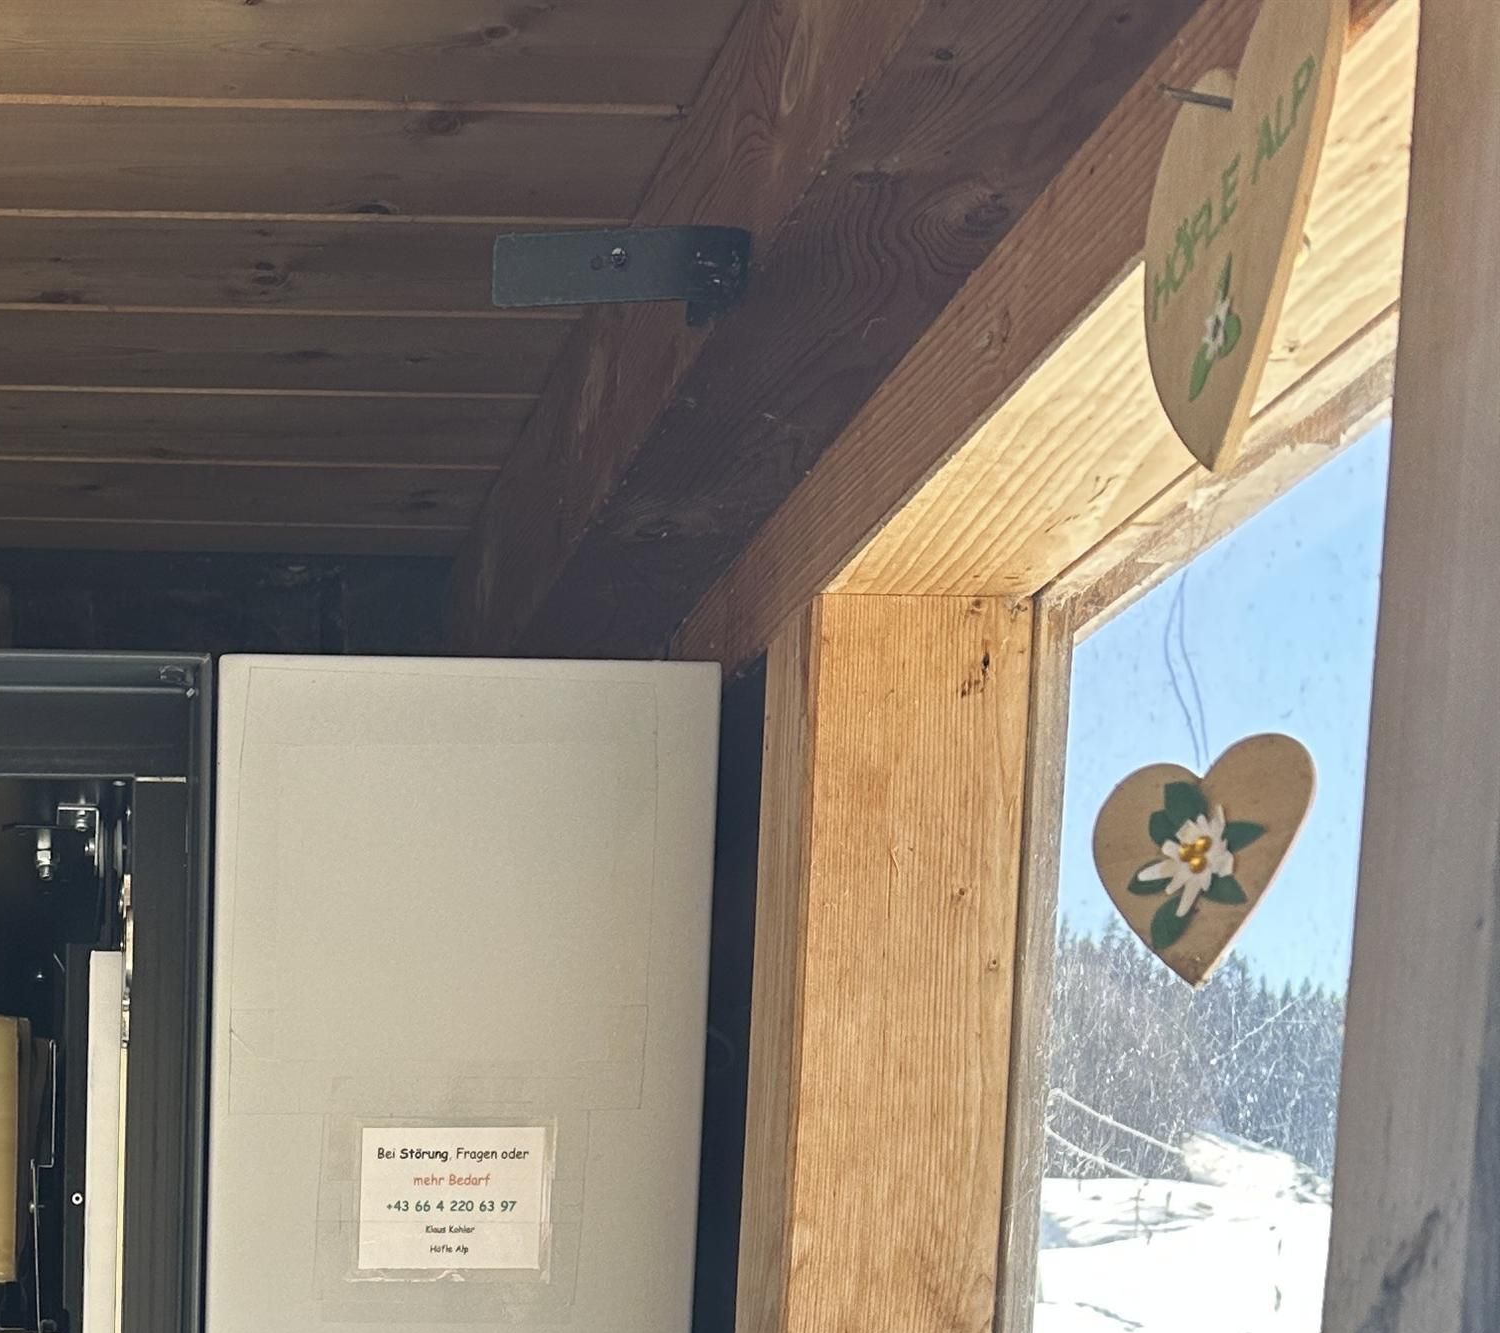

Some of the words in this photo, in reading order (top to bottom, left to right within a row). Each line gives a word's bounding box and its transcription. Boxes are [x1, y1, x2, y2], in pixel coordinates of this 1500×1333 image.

[1252, 56, 1315, 184] ALP
[377, 1147, 395, 1160] Bei
[399, 1148, 451, 1162] Störung,
[456, 1148, 497, 1162] Fragen
[501, 1148, 529, 1160] oder
[413, 1174, 445, 1186] mehr
[449, 1173, 491, 1186] Bedarf
[386, 1200, 409, 1212] +43
[415, 1200, 431, 1212] 66
[436, 1200, 444, 1212] 4
[450, 1200, 474, 1212] 220
[479, 1200, 494, 1212] 63
[500, 1200, 517, 1212] 97
